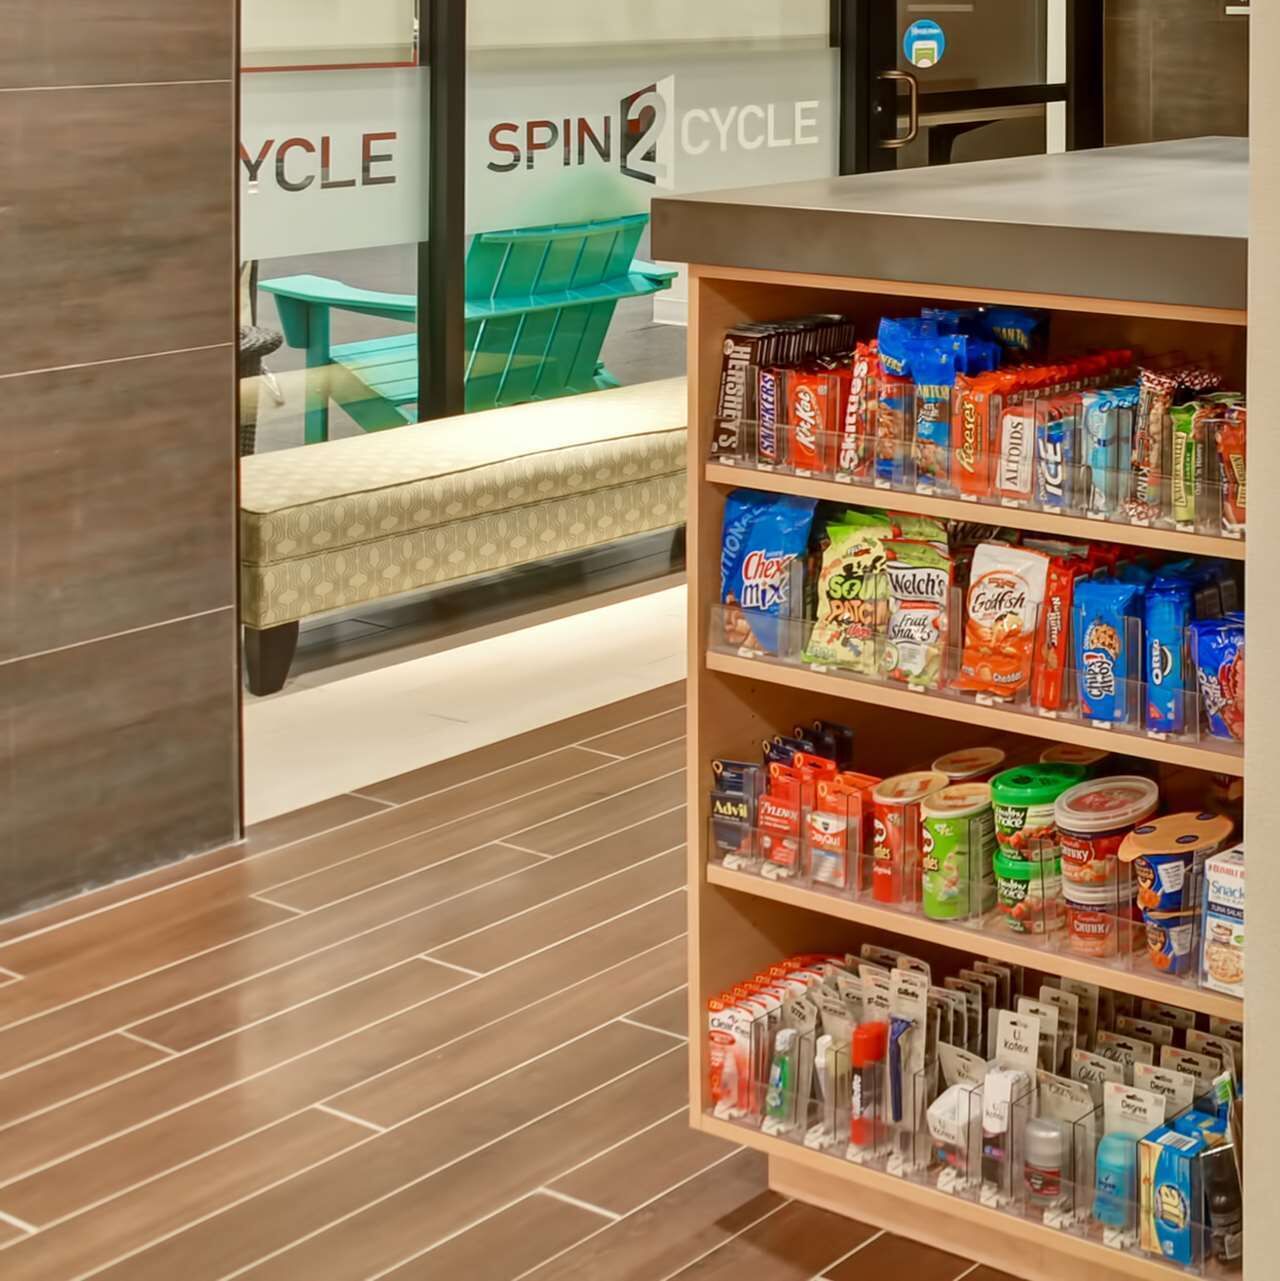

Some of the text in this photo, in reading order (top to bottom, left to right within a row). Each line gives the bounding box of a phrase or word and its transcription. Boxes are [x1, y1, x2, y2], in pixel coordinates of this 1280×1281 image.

[486, 115, 611, 172] SPIN
[680, 99, 820, 156] CYCLE
[1005, 420, 1024, 487] ALTOIDS
[1039, 437, 1063, 497] ICE
[742, 551, 796, 583] Chex
[741, 581, 788, 610] mix
[889, 571, 946, 598] Welch's
[971, 589, 1026, 614] Goldfish
[899, 613, 929, 631] Fruit
[1152, 639, 1162, 685] OREO
[713, 800, 748, 818] Advil
